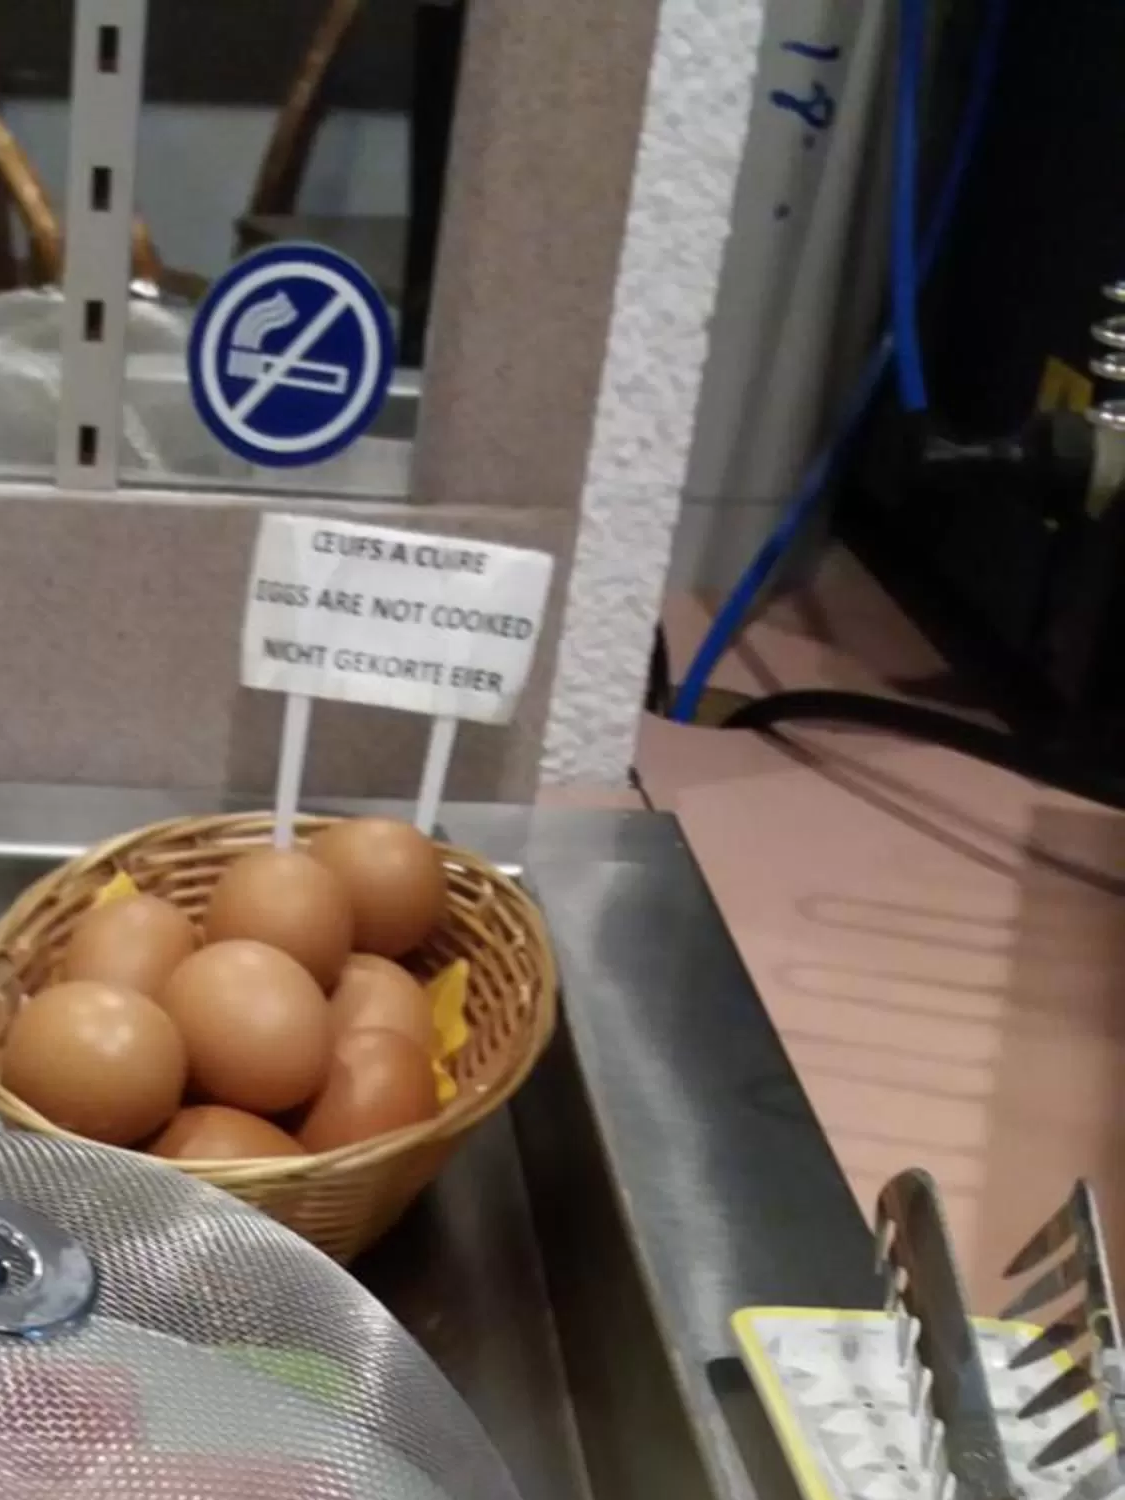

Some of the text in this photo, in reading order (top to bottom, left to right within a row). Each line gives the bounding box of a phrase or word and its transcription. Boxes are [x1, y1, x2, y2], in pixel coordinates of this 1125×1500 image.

[389, 544, 409, 566] A
[316, 589, 364, 616] ARE
[371, 597, 428, 624] NOT
[430, 606, 535, 640] COOKED
[448, 666, 504, 694] EIER
